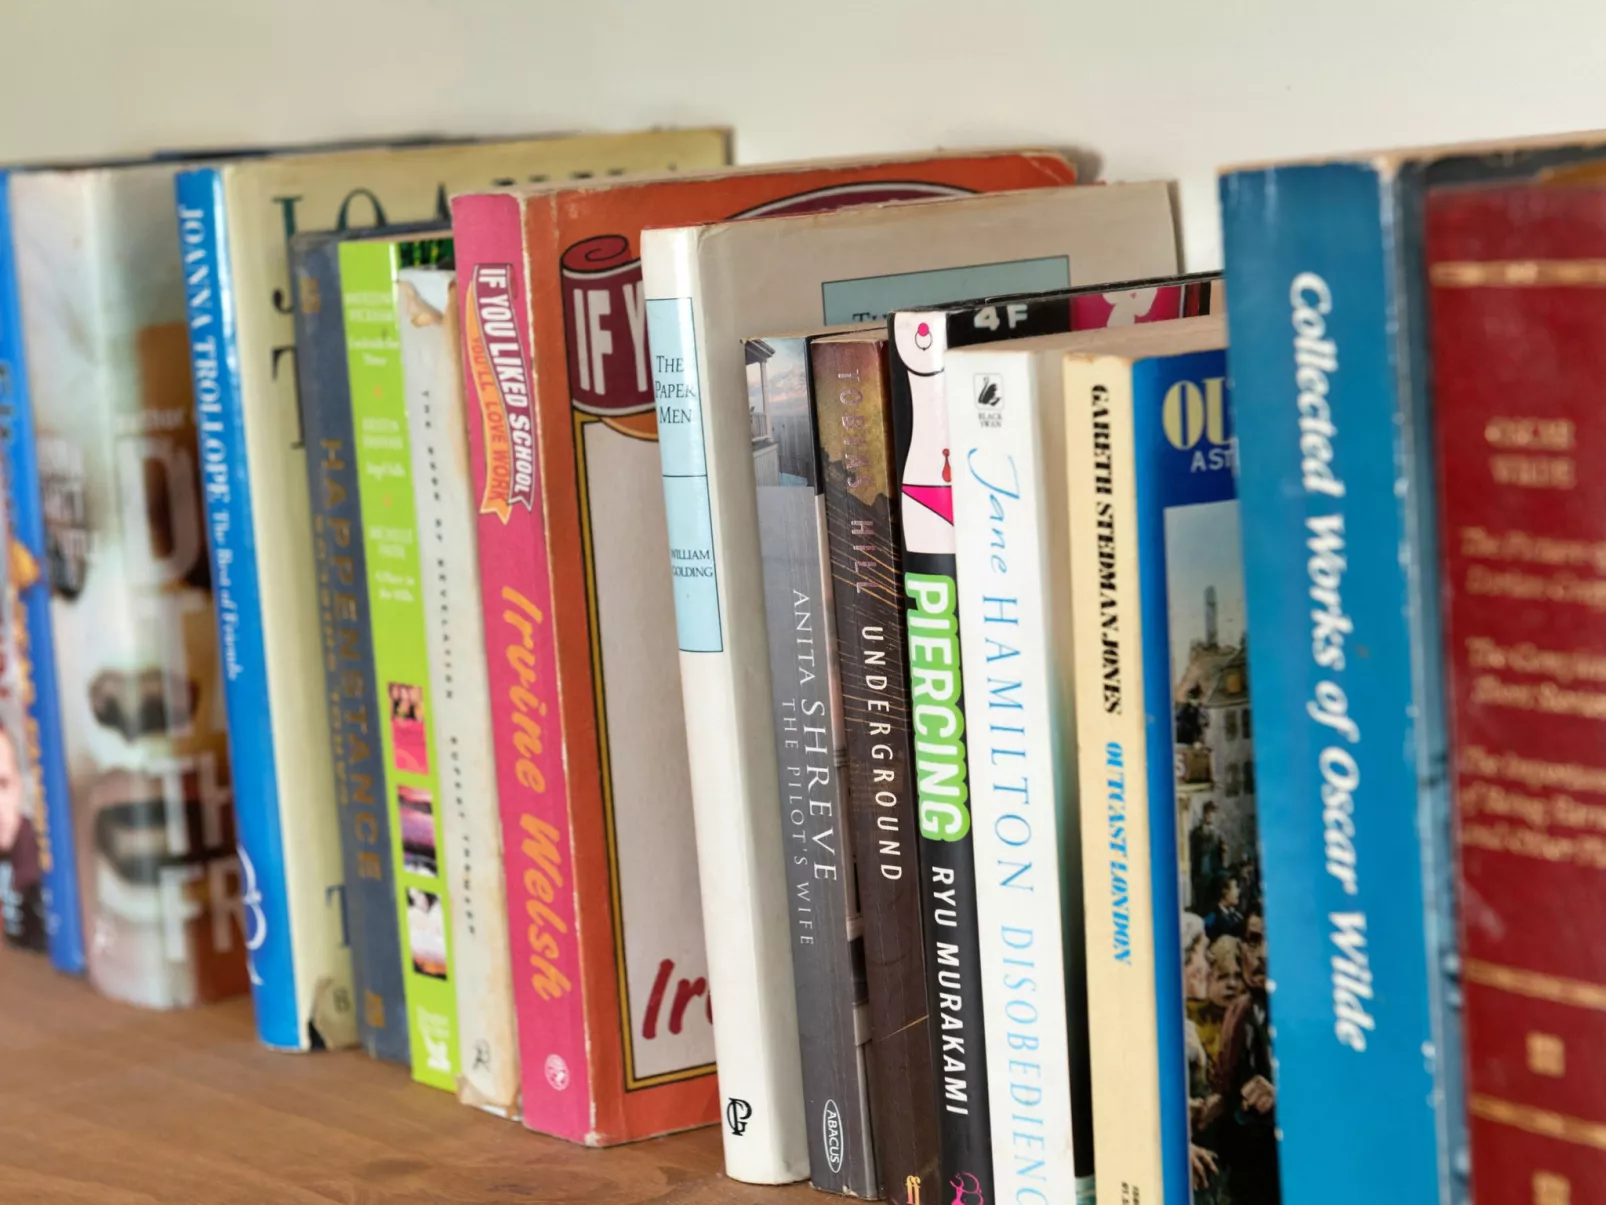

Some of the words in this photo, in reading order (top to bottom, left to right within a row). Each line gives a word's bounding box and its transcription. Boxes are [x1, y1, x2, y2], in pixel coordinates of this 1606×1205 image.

[178, 203, 213, 329] JOANNA
[478, 268, 507, 289] IF
[479, 293, 517, 338] YOU
[488, 342, 528, 408] LIKED
[573, 288, 613, 395] IF
[655, 380, 696, 399] PAPER
[656, 355, 685, 373] THE
[1289, 271, 1346, 498] Collected
[192, 335, 232, 504] TROLLOPE
[486, 400, 507, 444] LOVE
[509, 412, 533, 493] SCHOOL
[659, 406, 692, 424] MEN
[838, 368, 871, 489] TOBIAS
[1091, 385, 1113, 495] GARETH
[491, 450, 511, 501] WORK
[967, 448, 1020, 574] Jane
[850, 520, 879, 594] HILL
[1097, 501, 1118, 631] STEDMAN
[1305, 513, 1354, 672] Works
[320, 438, 383, 881] HAPPENSTANCE
[501, 583, 546, 795] Irvine
[793, 588, 816, 685] ANITA
[1102, 631, 1121, 715] JONES
[781, 698, 799, 749] THE
[861, 626, 903, 881] UNDERGROUND
[906, 576, 966, 838] PIERCING
[983, 595, 1035, 893] HAMILTON
[1306, 680, 1360, 744] of
[787, 766, 809, 866] PILOT'S
[801, 698, 838, 881] SHREVE
[1105, 741, 1128, 859] OUTCAST
[1318, 745, 1361, 896] Oscar
[519, 811, 573, 1004] Welsh
[796, 881, 815, 945] WIFE
[932, 866, 957, 928] RYU
[1110, 860, 1132, 966] LONDON
[642, 958, 714, 1040] Ir
[936, 941, 969, 1115] MURAKAMI
[1328, 910, 1376, 1054] Wilde
[825, 1108, 841, 1164] ABACUS
